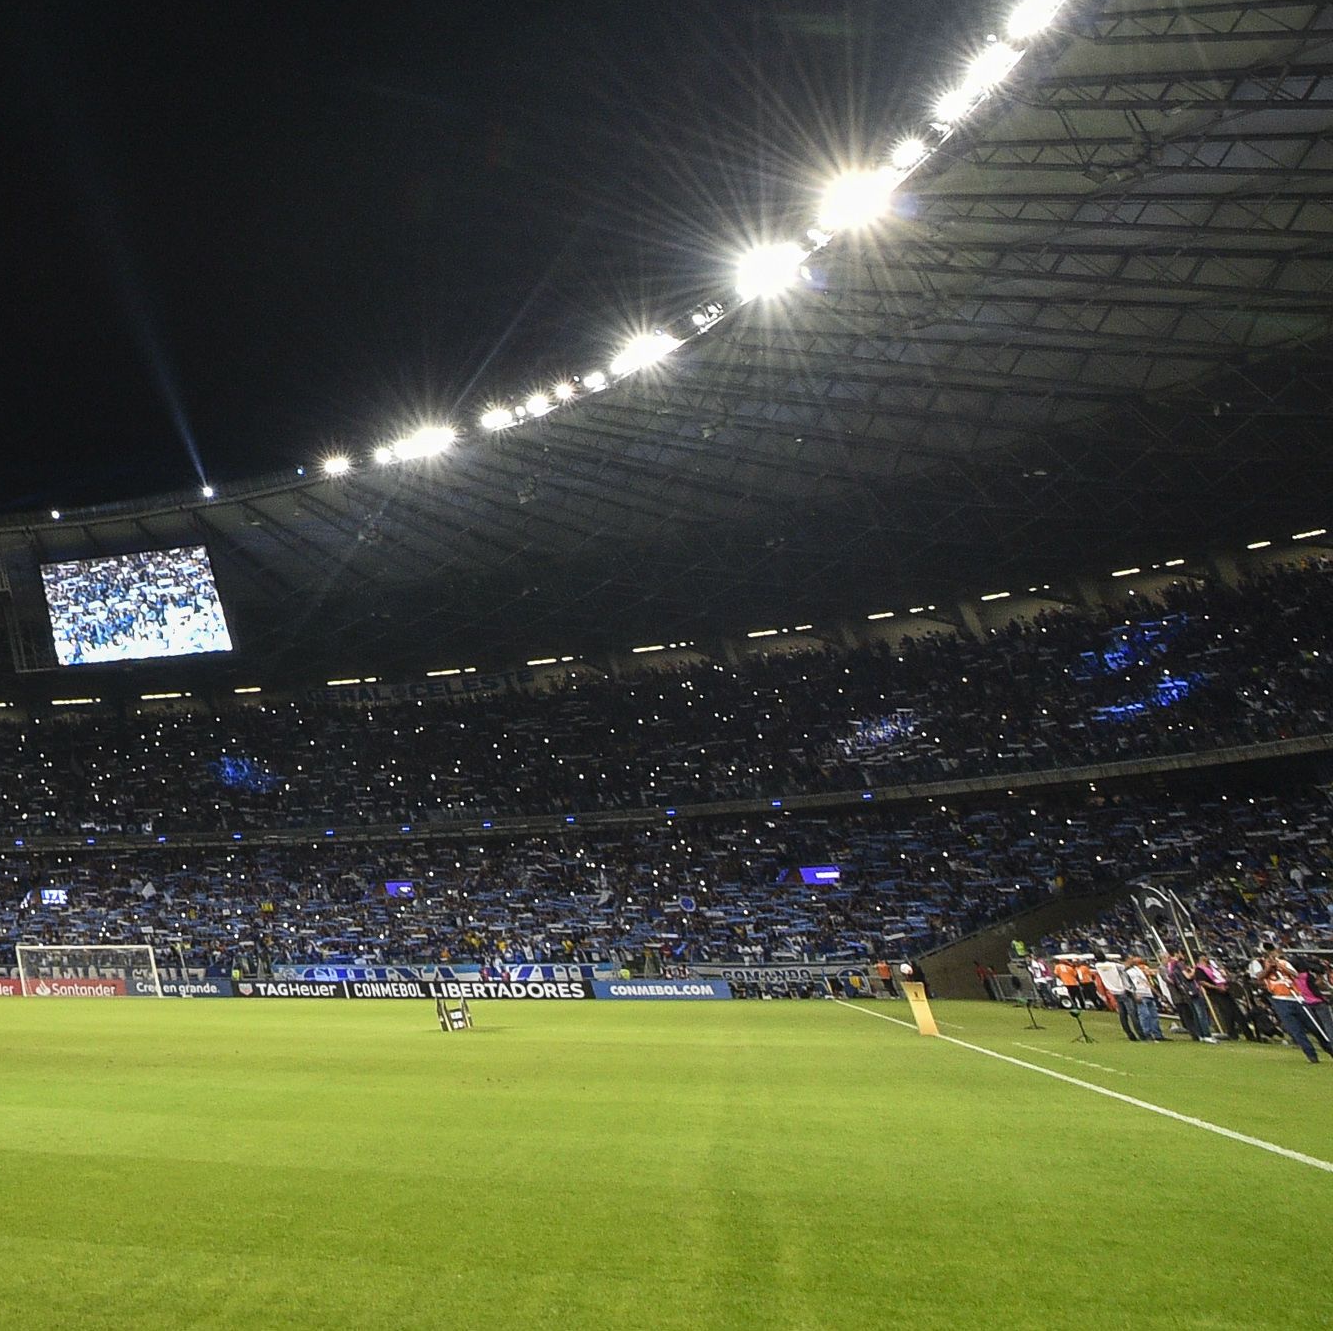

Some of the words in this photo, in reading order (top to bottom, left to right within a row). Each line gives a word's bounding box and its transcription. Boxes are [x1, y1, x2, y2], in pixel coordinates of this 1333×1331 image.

[51, 983, 116, 997] Santander
[136, 982, 160, 994] Cre
[163, 984, 177, 994] en
[354, 982, 426, 998] CONMEBOL
[430, 982, 585, 999] LIBERTADORES
[610, 984, 714, 997] CONMEBOL.COM
